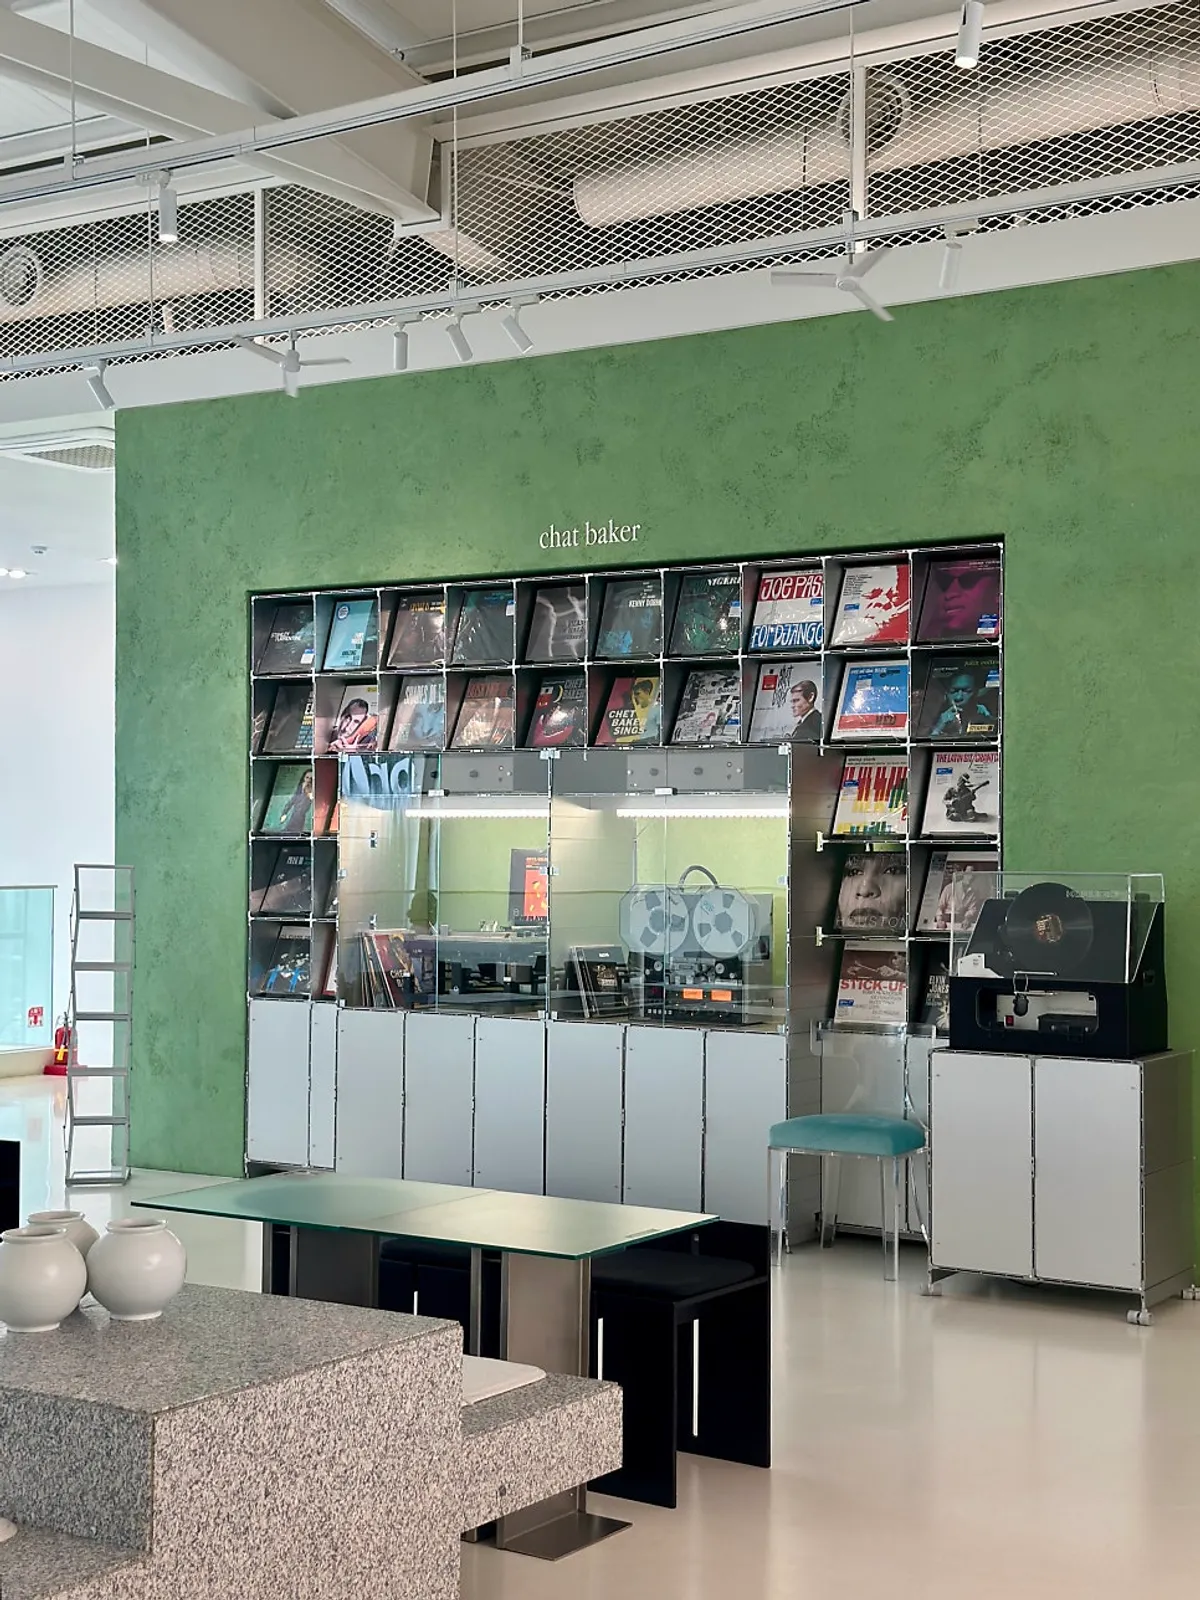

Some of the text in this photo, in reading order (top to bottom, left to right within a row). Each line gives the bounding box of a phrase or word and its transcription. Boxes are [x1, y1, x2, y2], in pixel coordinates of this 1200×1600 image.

[540, 519, 641, 548] chat baker
[761, 577, 793, 600] JOE
[793, 575, 823, 599] PAS
[773, 623, 823, 646] DJANGO
[608, 710, 636, 719] CHET
[613, 726, 646, 736] SINGS
[840, 980, 907, 991] STICK-UP
[929, 983, 950, 994] JONES
